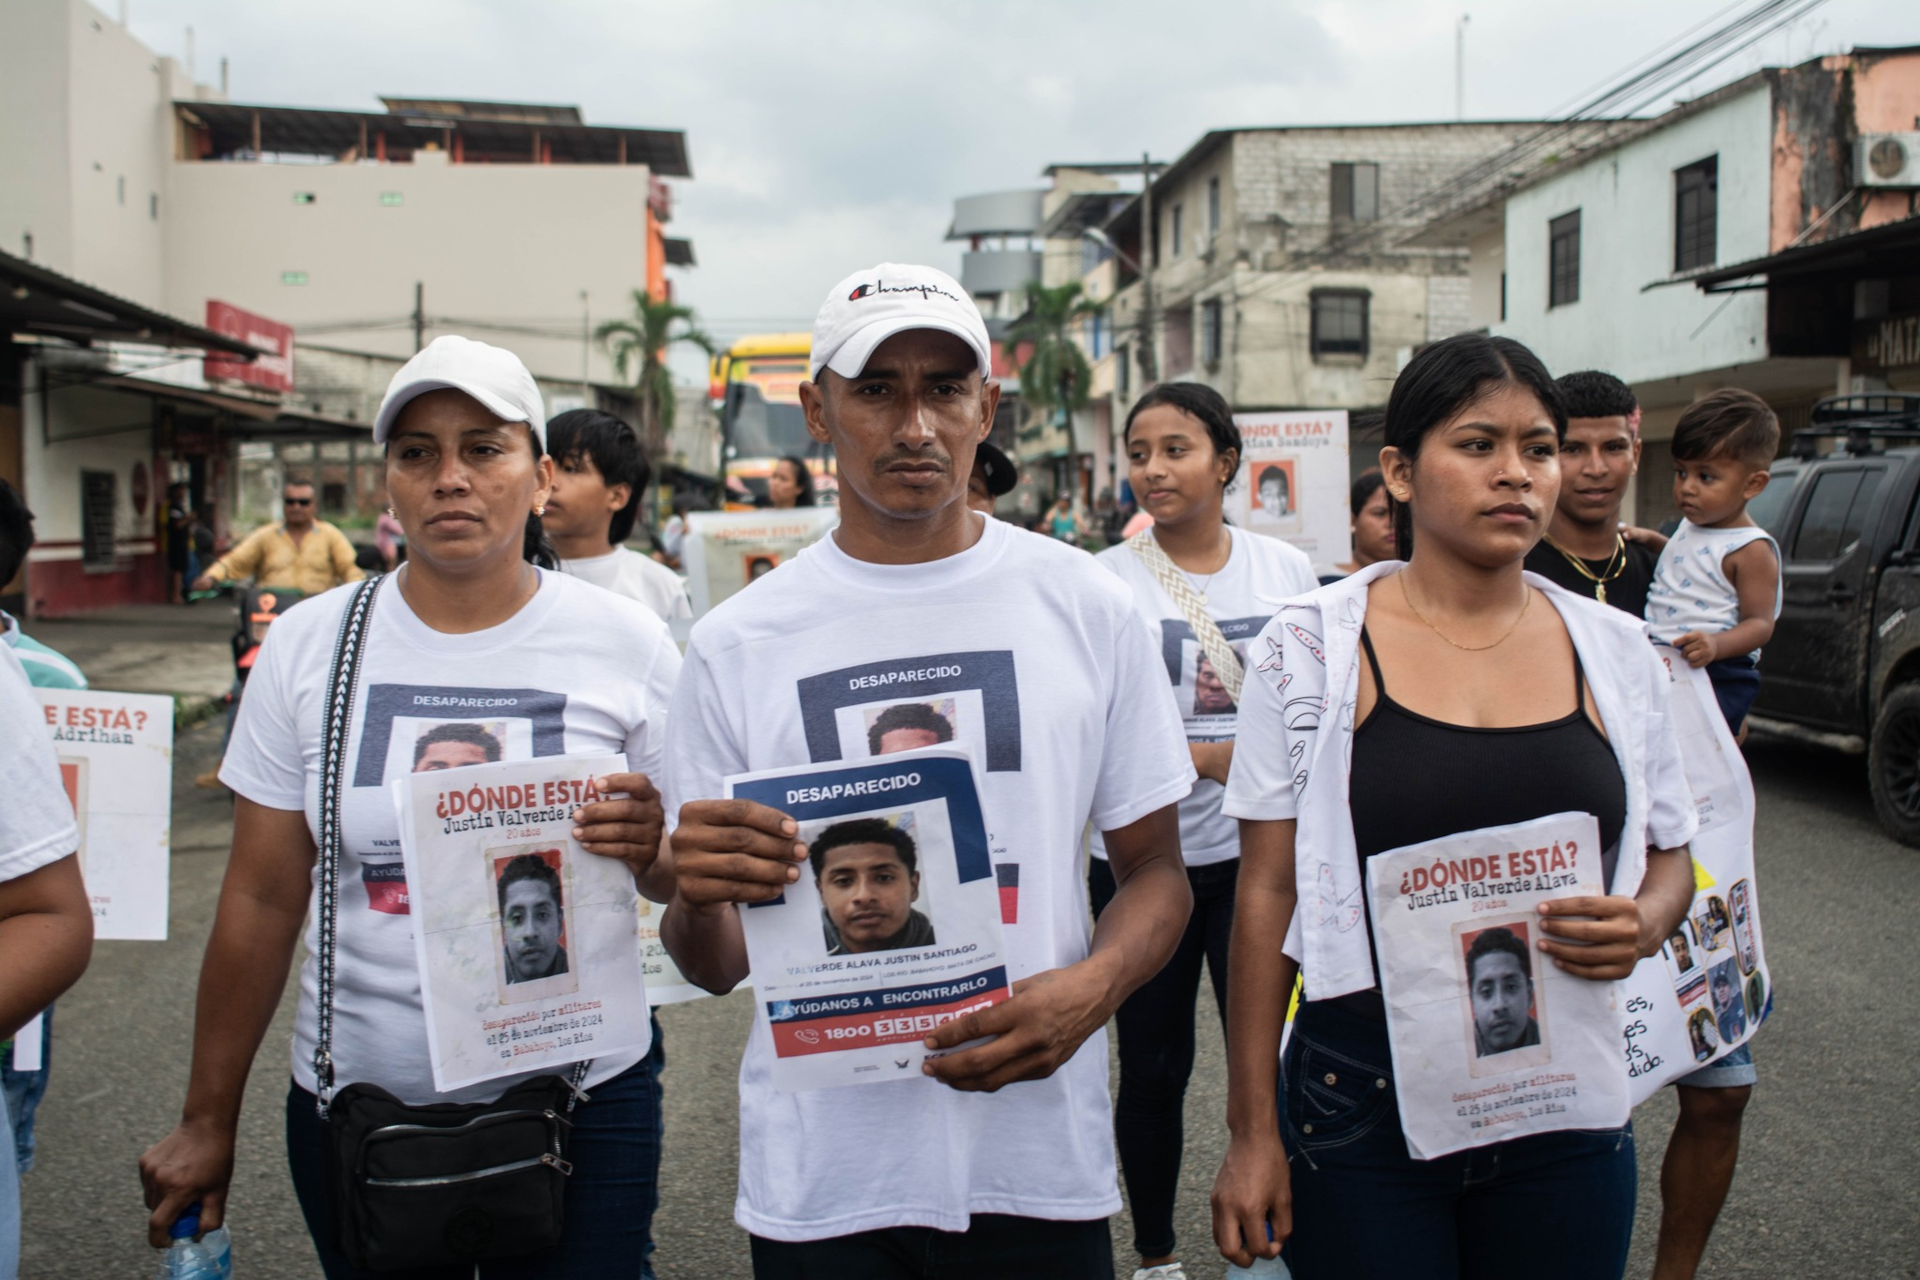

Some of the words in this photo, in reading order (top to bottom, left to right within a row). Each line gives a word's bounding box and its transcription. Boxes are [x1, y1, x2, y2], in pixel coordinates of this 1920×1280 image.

[849, 665, 962, 691] DESAPARECIDO
[413, 695, 518, 708] DESAPARECIDO
[66, 706, 148, 731] ESTÁ?
[53, 726, 134, 745] Adrihan
[436, 783, 537, 819] ¿DÓNDE
[543, 774, 610, 805] ESTÁ
[786, 772, 922, 804] DESAPARECIDO
[497, 806, 564, 828] Valverde
[506, 829, 519, 839] 20
[520, 827, 541, 838] años
[1400, 858, 1502, 895] ¿DÓNDE
[1508, 840, 1578, 877] ESTÁ?
[1461, 878, 1531, 899] Valverde
[1534, 872, 1577, 891] Alava
[1471, 901, 1484, 912] 20
[787, 962, 843, 976] VALVERDE
[846, 958, 880, 969] ALAVA
[883, 954, 921, 965] JUSTIN
[923, 943, 977, 960] SANTIAGO
[862, 997, 875, 1007] A
[882, 976, 988, 1005] ENCONTRARLO
[482, 1011, 540, 1031] desaparecido
[541, 1009, 557, 1021] por
[558, 1000, 602, 1016] militares
[486, 1034, 498, 1046] el
[499, 1032, 510, 1044] 25
[511, 1029, 522, 1041] de
[523, 1022, 568, 1039] noviembre
[570, 1018, 580, 1029] de
[581, 1014, 603, 1027] 2024
[824, 1025, 872, 1039] 1800
[500, 1049, 512, 1058] en
[557, 1036, 573, 1047] los
[1452, 1083, 1512, 1103] desaparecido
[1512, 1080, 1528, 1093] por
[1457, 1105, 1468, 1116] el
[1469, 1104, 1480, 1115] 25
[1482, 1101, 1493, 1112] de
[1494, 1093, 1540, 1109] noviembre
[1541, 1090, 1552, 1100] de
[1553, 1086, 1577, 1098] 2024
[1470, 1120, 1482, 1129] en
[1528, 1106, 1544, 1117] los
